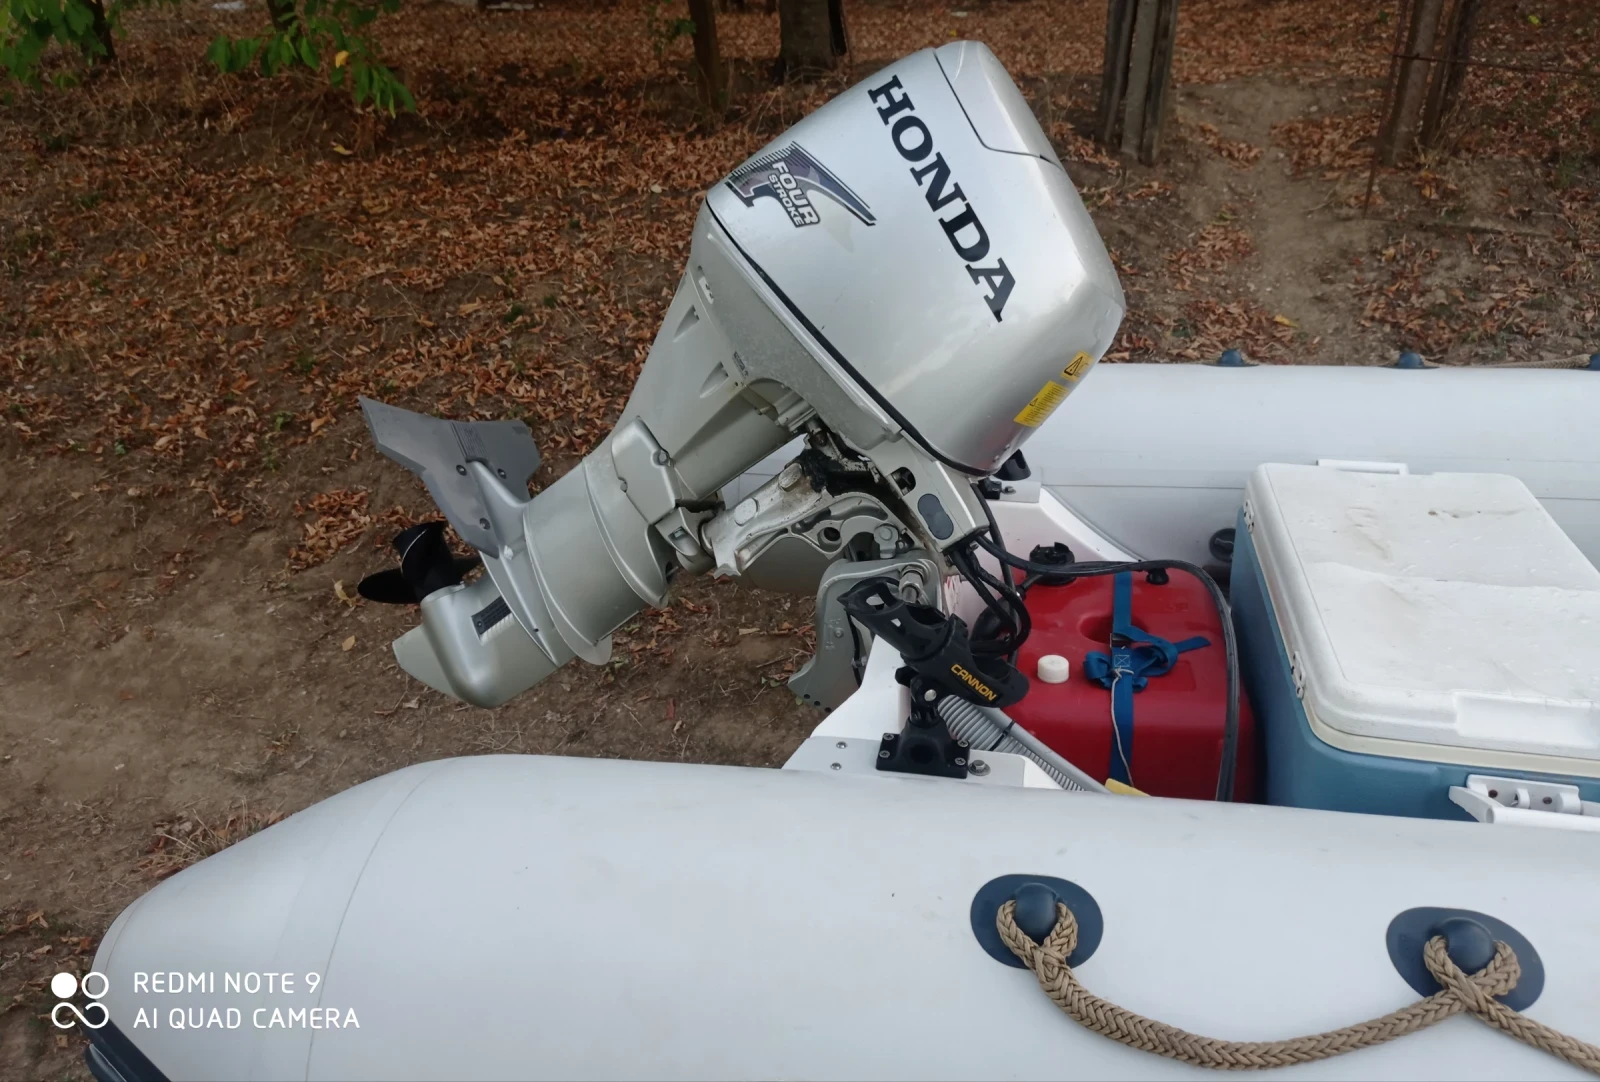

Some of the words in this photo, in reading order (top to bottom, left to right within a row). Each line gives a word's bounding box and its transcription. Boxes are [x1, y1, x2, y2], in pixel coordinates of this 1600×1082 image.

[768, 173, 805, 227] STROKE
[772, 161, 819, 225] FOUR
[867, 75, 1016, 323] HONDA
[951, 664, 997, 701] CANNON
